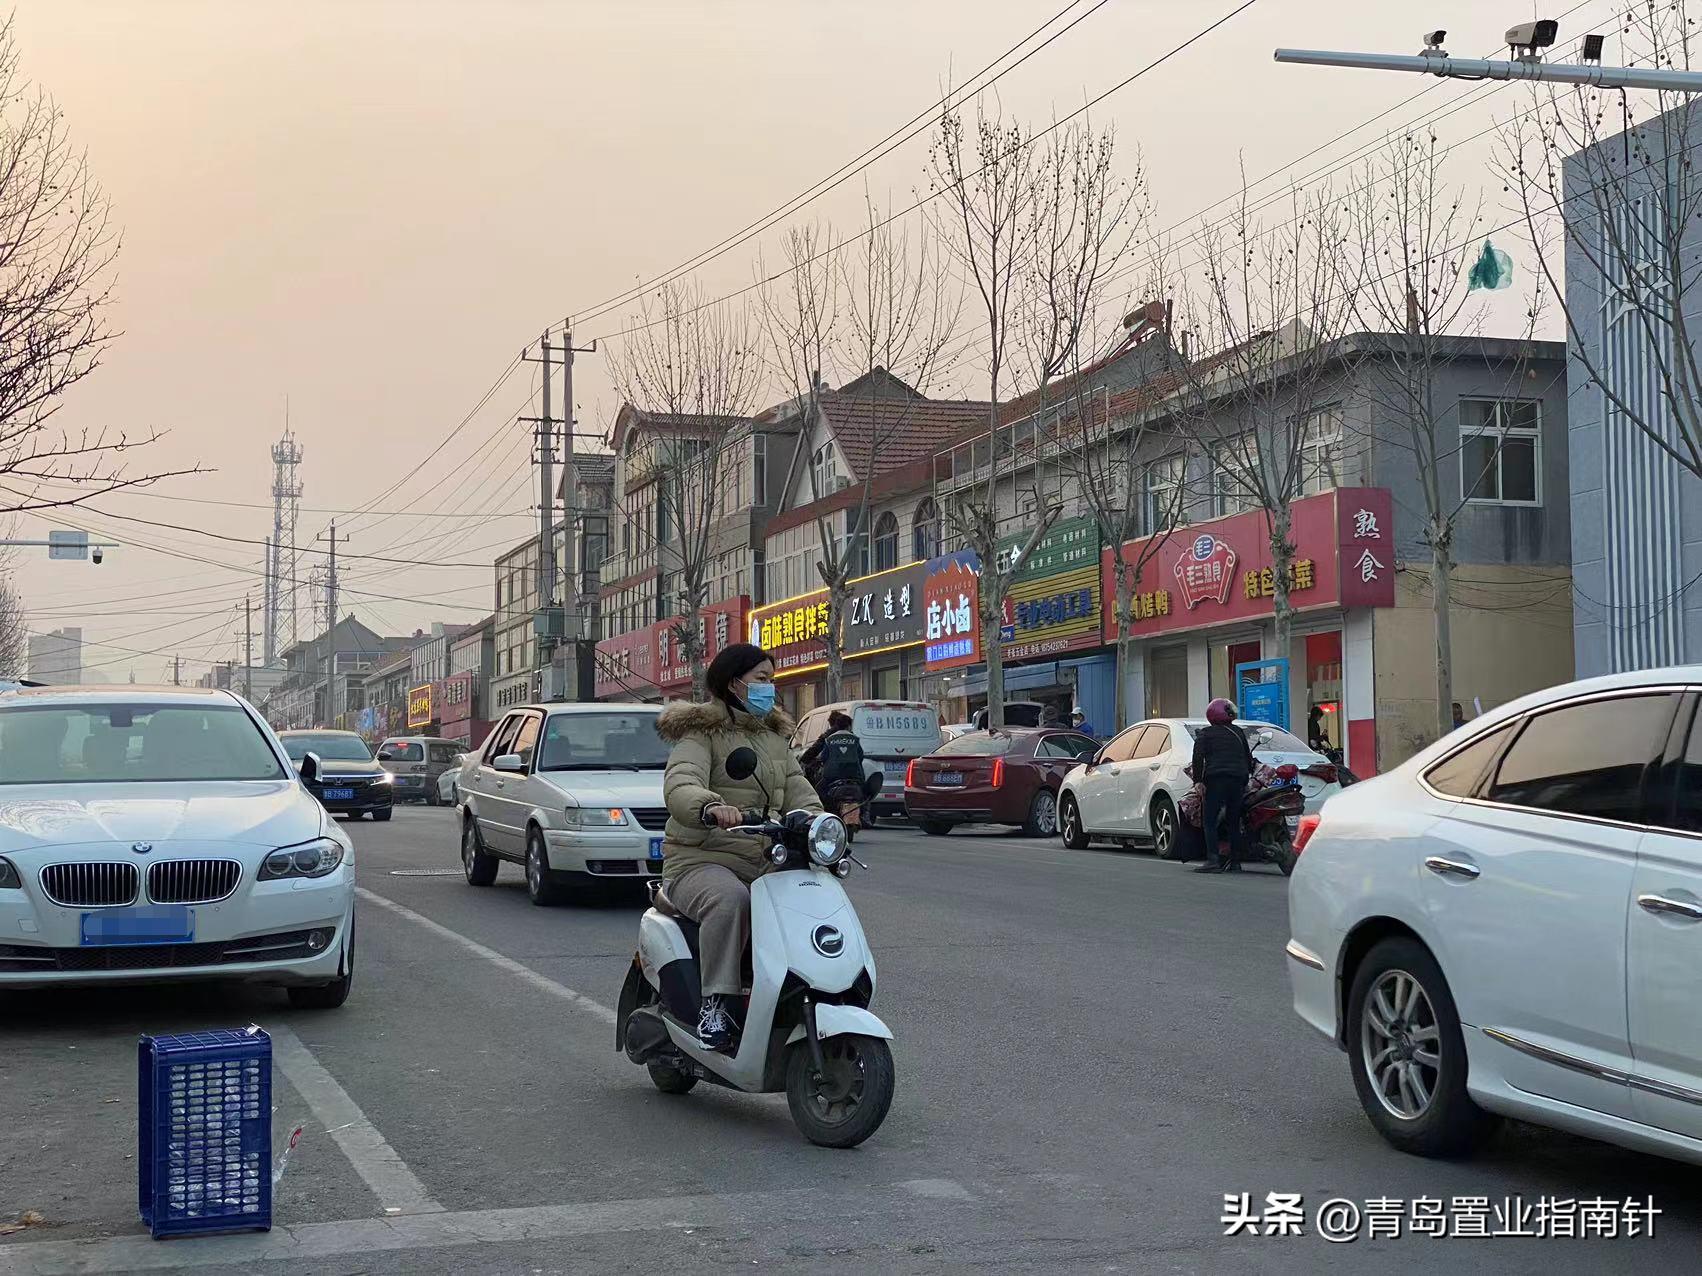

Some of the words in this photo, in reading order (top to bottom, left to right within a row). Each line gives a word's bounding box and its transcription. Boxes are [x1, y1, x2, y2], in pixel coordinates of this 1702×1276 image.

[1196, 540, 1211, 555] 毛三
[1352, 508, 1385, 583] 熟食
[1187, 560, 1221, 586] 毛三熟食
[1243, 559, 1314, 599] 特色菜
[850, 593, 875, 626] ZK
[883, 583, 912, 621] 造型
[926, 594, 971, 640] 店小卤
